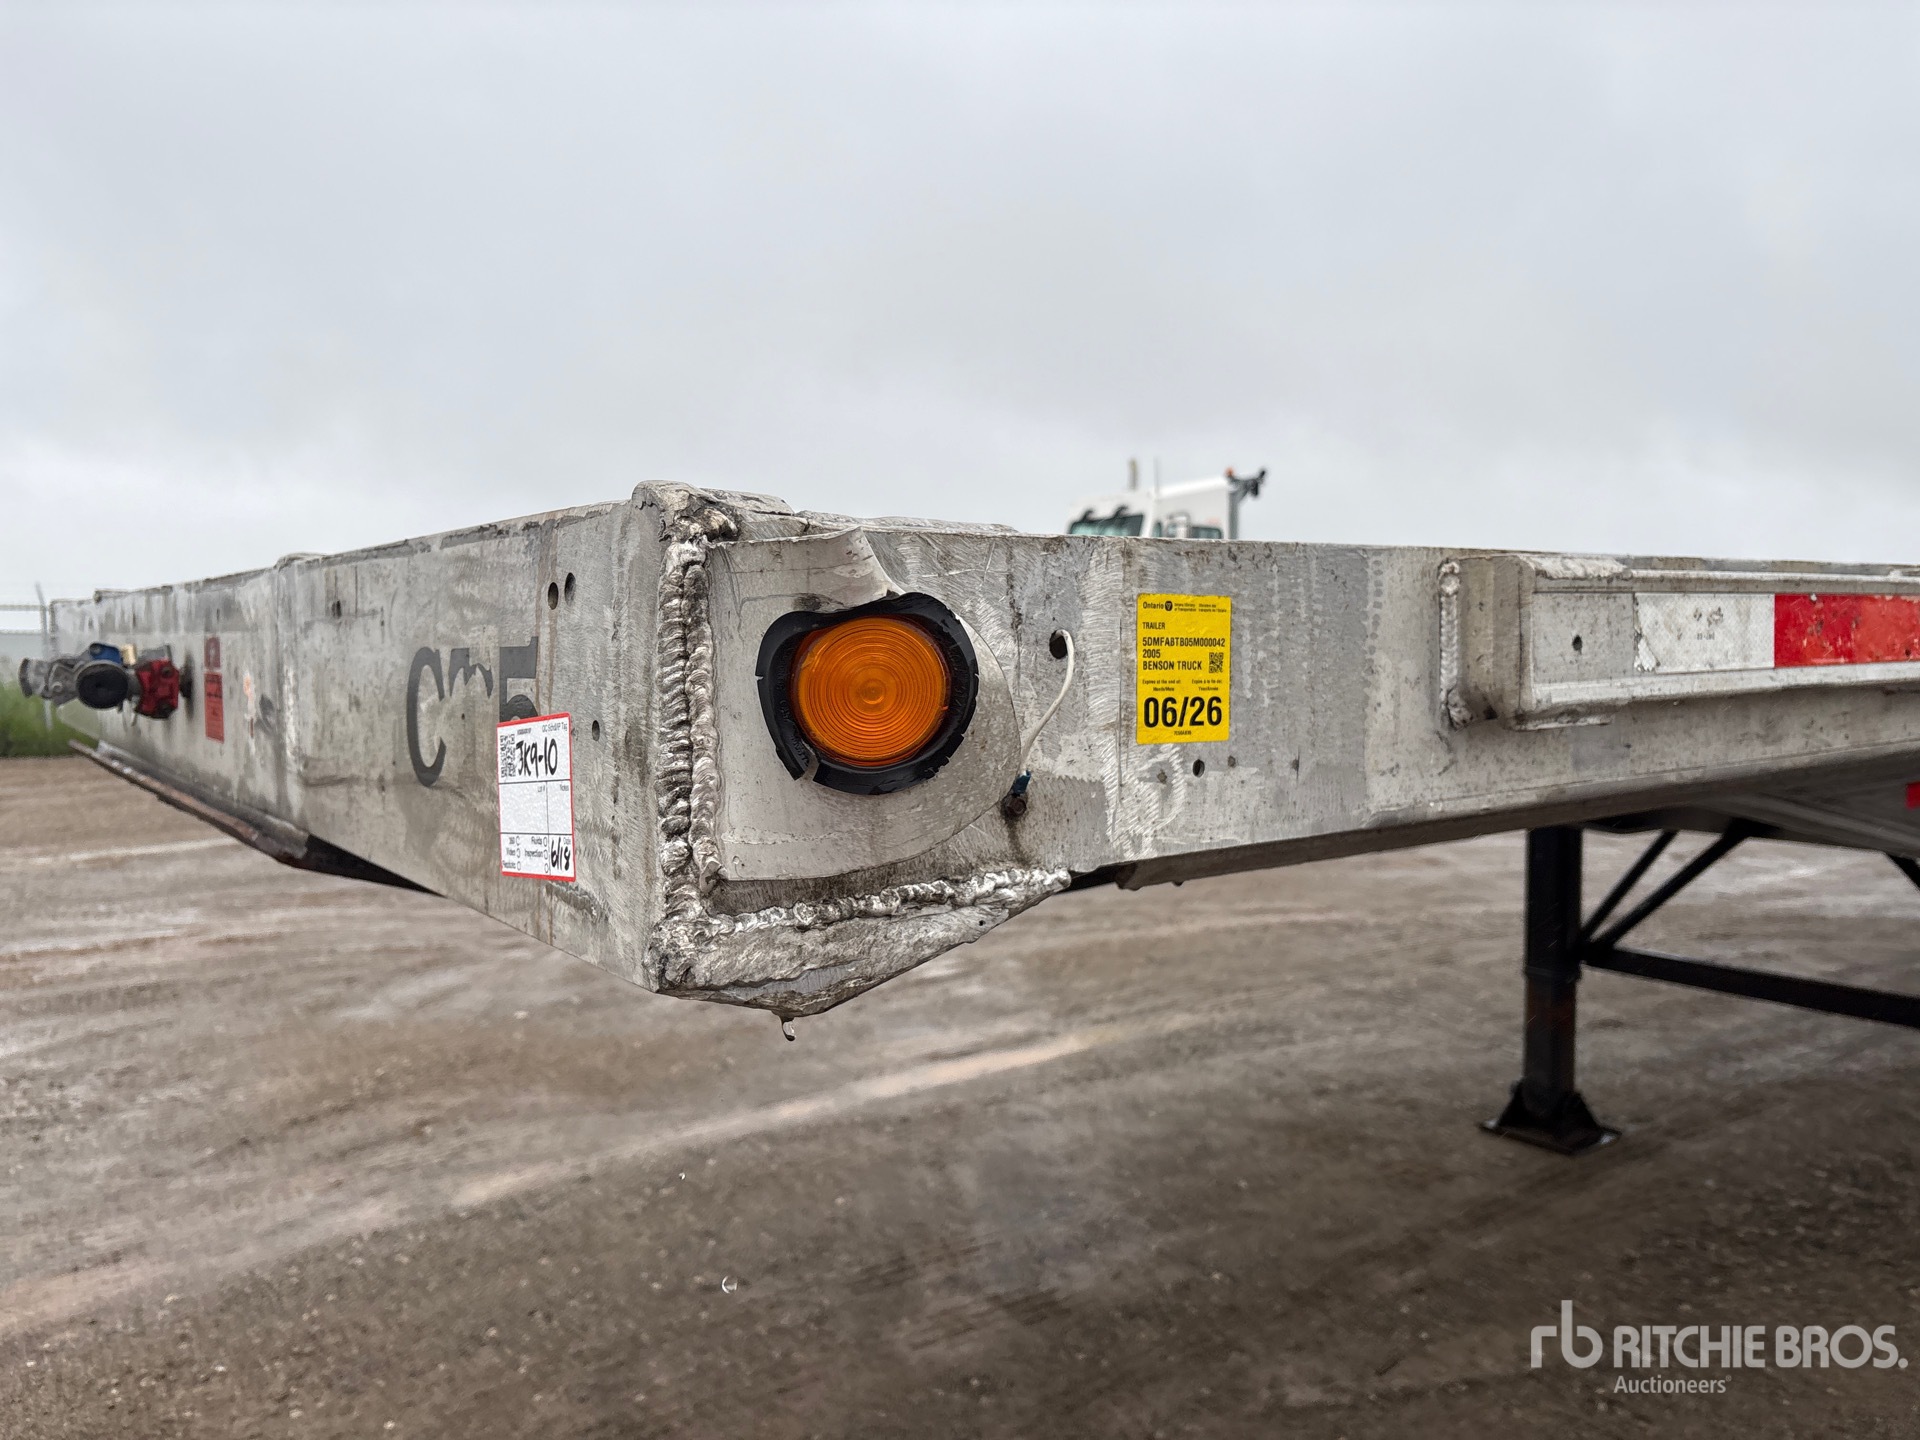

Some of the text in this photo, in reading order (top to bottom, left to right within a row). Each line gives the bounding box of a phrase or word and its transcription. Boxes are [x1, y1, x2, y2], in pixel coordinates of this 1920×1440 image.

[1143, 601, 1164, 610] Ontario
[1142, 622, 1166, 630] TRAILER
[1142, 649, 1161, 659] 2005
[1142, 661, 1203, 671] BENSON TRUCK
[1144, 696, 1222, 728] 06/26
